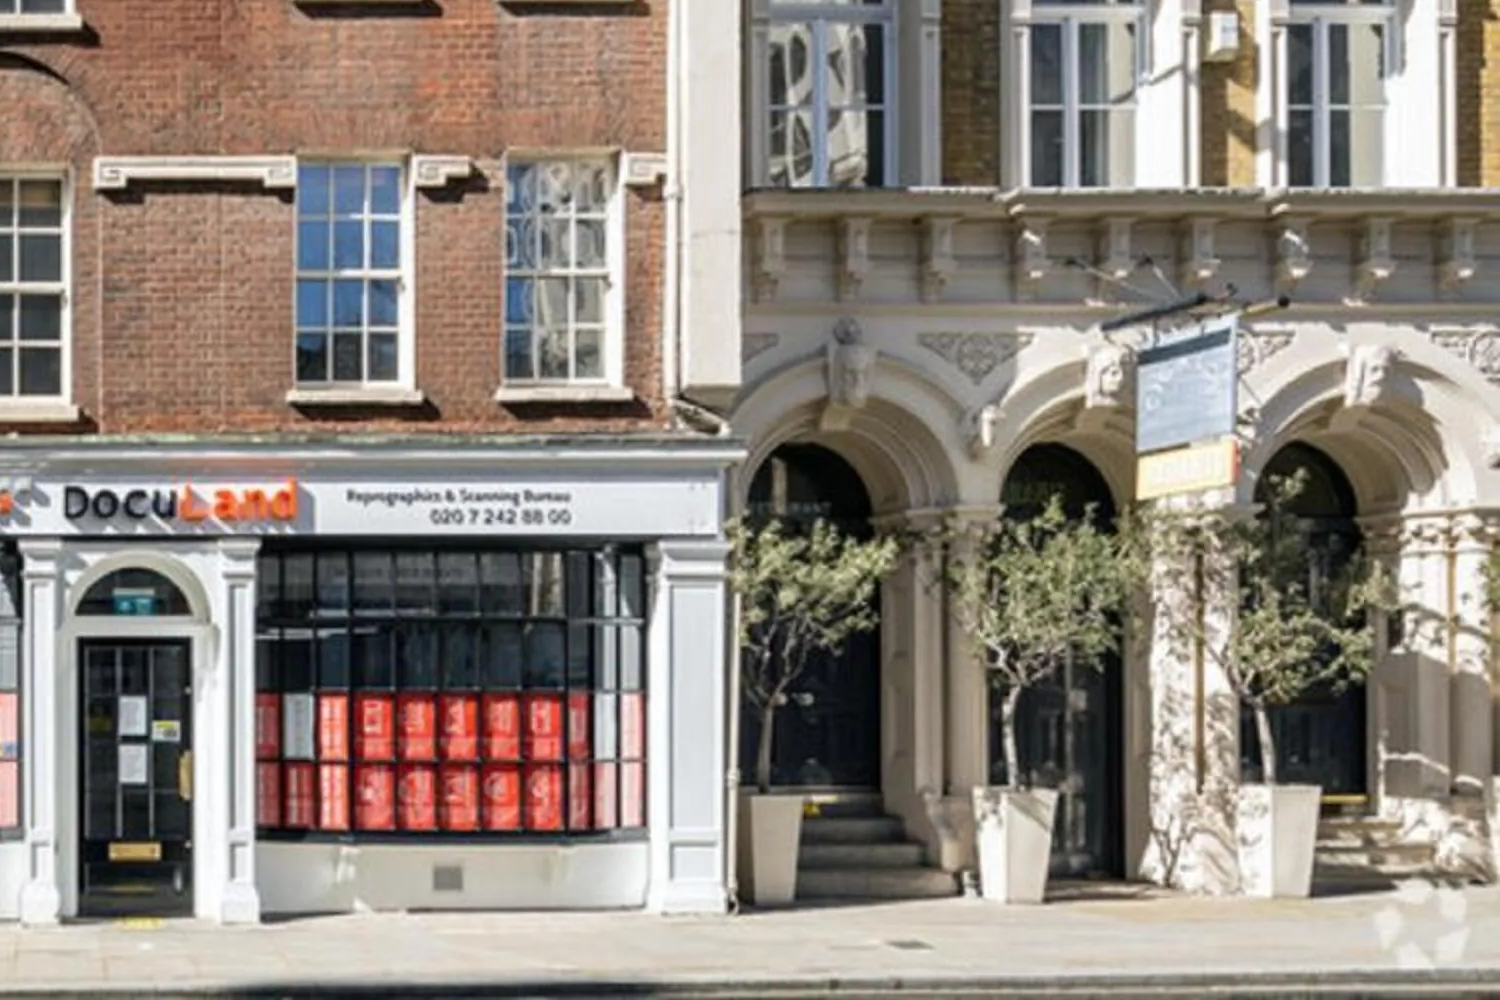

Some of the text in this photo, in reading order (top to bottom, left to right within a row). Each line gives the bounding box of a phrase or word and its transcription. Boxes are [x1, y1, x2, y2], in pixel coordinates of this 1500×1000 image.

[445, 488, 455, 502] &
[459, 488, 520, 507] Scanning
[523, 488, 572, 502] Bureau
[429, 508, 465, 525] 020
[483, 508, 517, 525] 242
